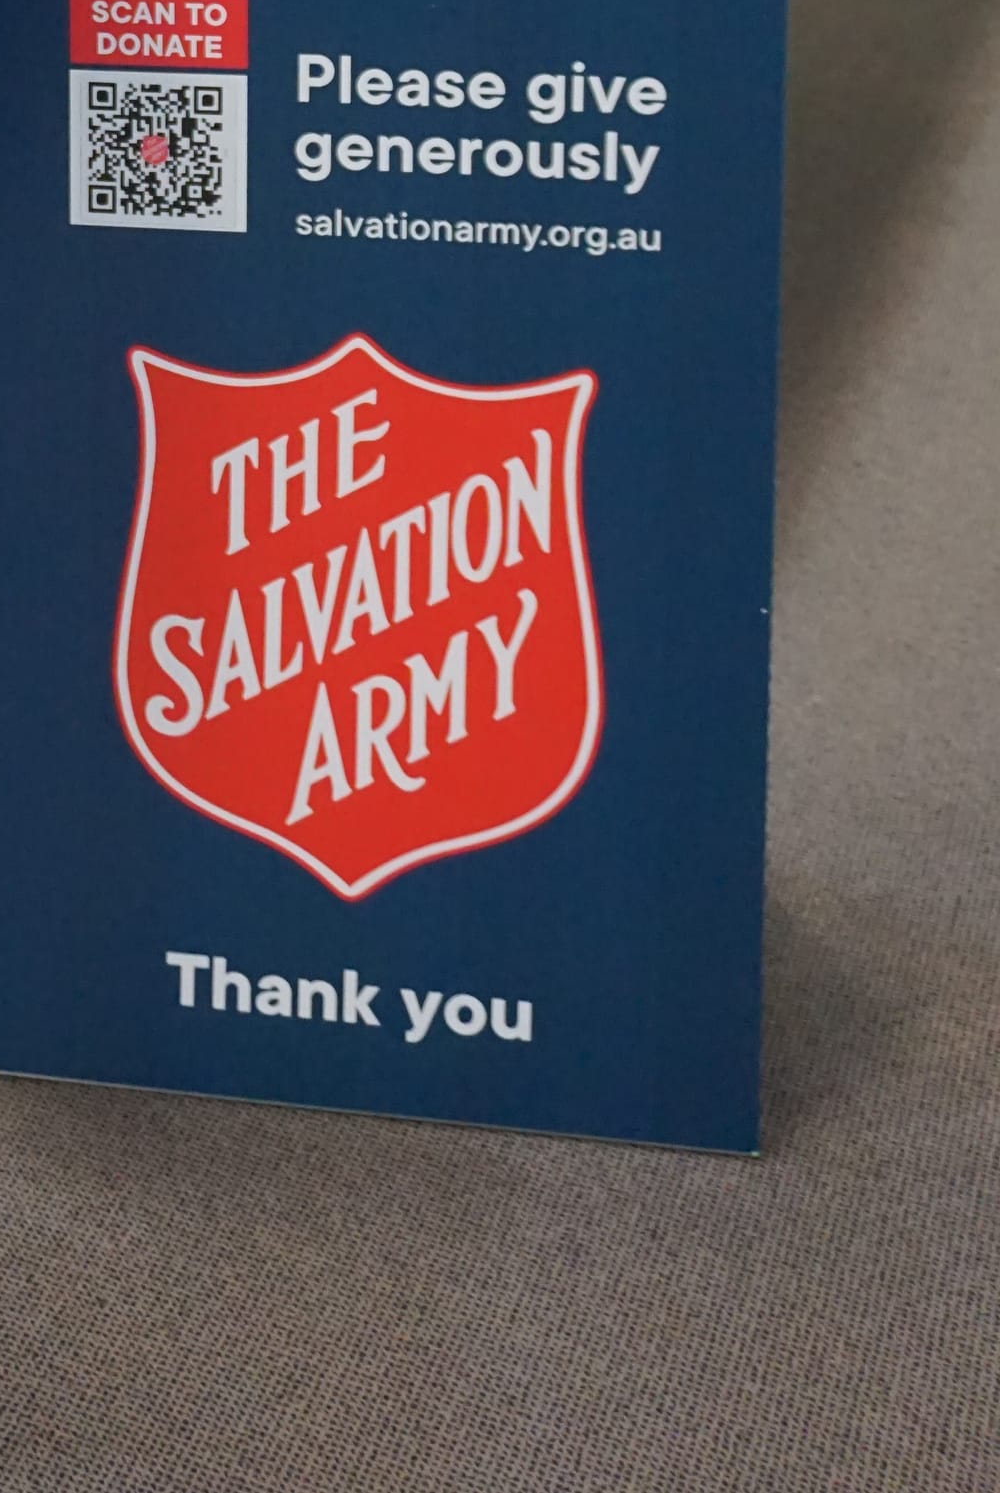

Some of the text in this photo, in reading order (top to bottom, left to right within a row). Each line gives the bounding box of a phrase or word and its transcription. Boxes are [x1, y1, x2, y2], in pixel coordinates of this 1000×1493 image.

[92, 0, 228, 26] SCAN TO
[96, 32, 223, 59] DONATE
[297, 53, 668, 124] Please give
[294, 131, 660, 194] generously
[296, 208, 662, 256] salvationarmy.org.au
[210, 388, 390, 556] THE
[144, 428, 552, 737] SALVATION
[285, 588, 538, 826] ARMY
[166, 951, 533, 1043] Thank you
